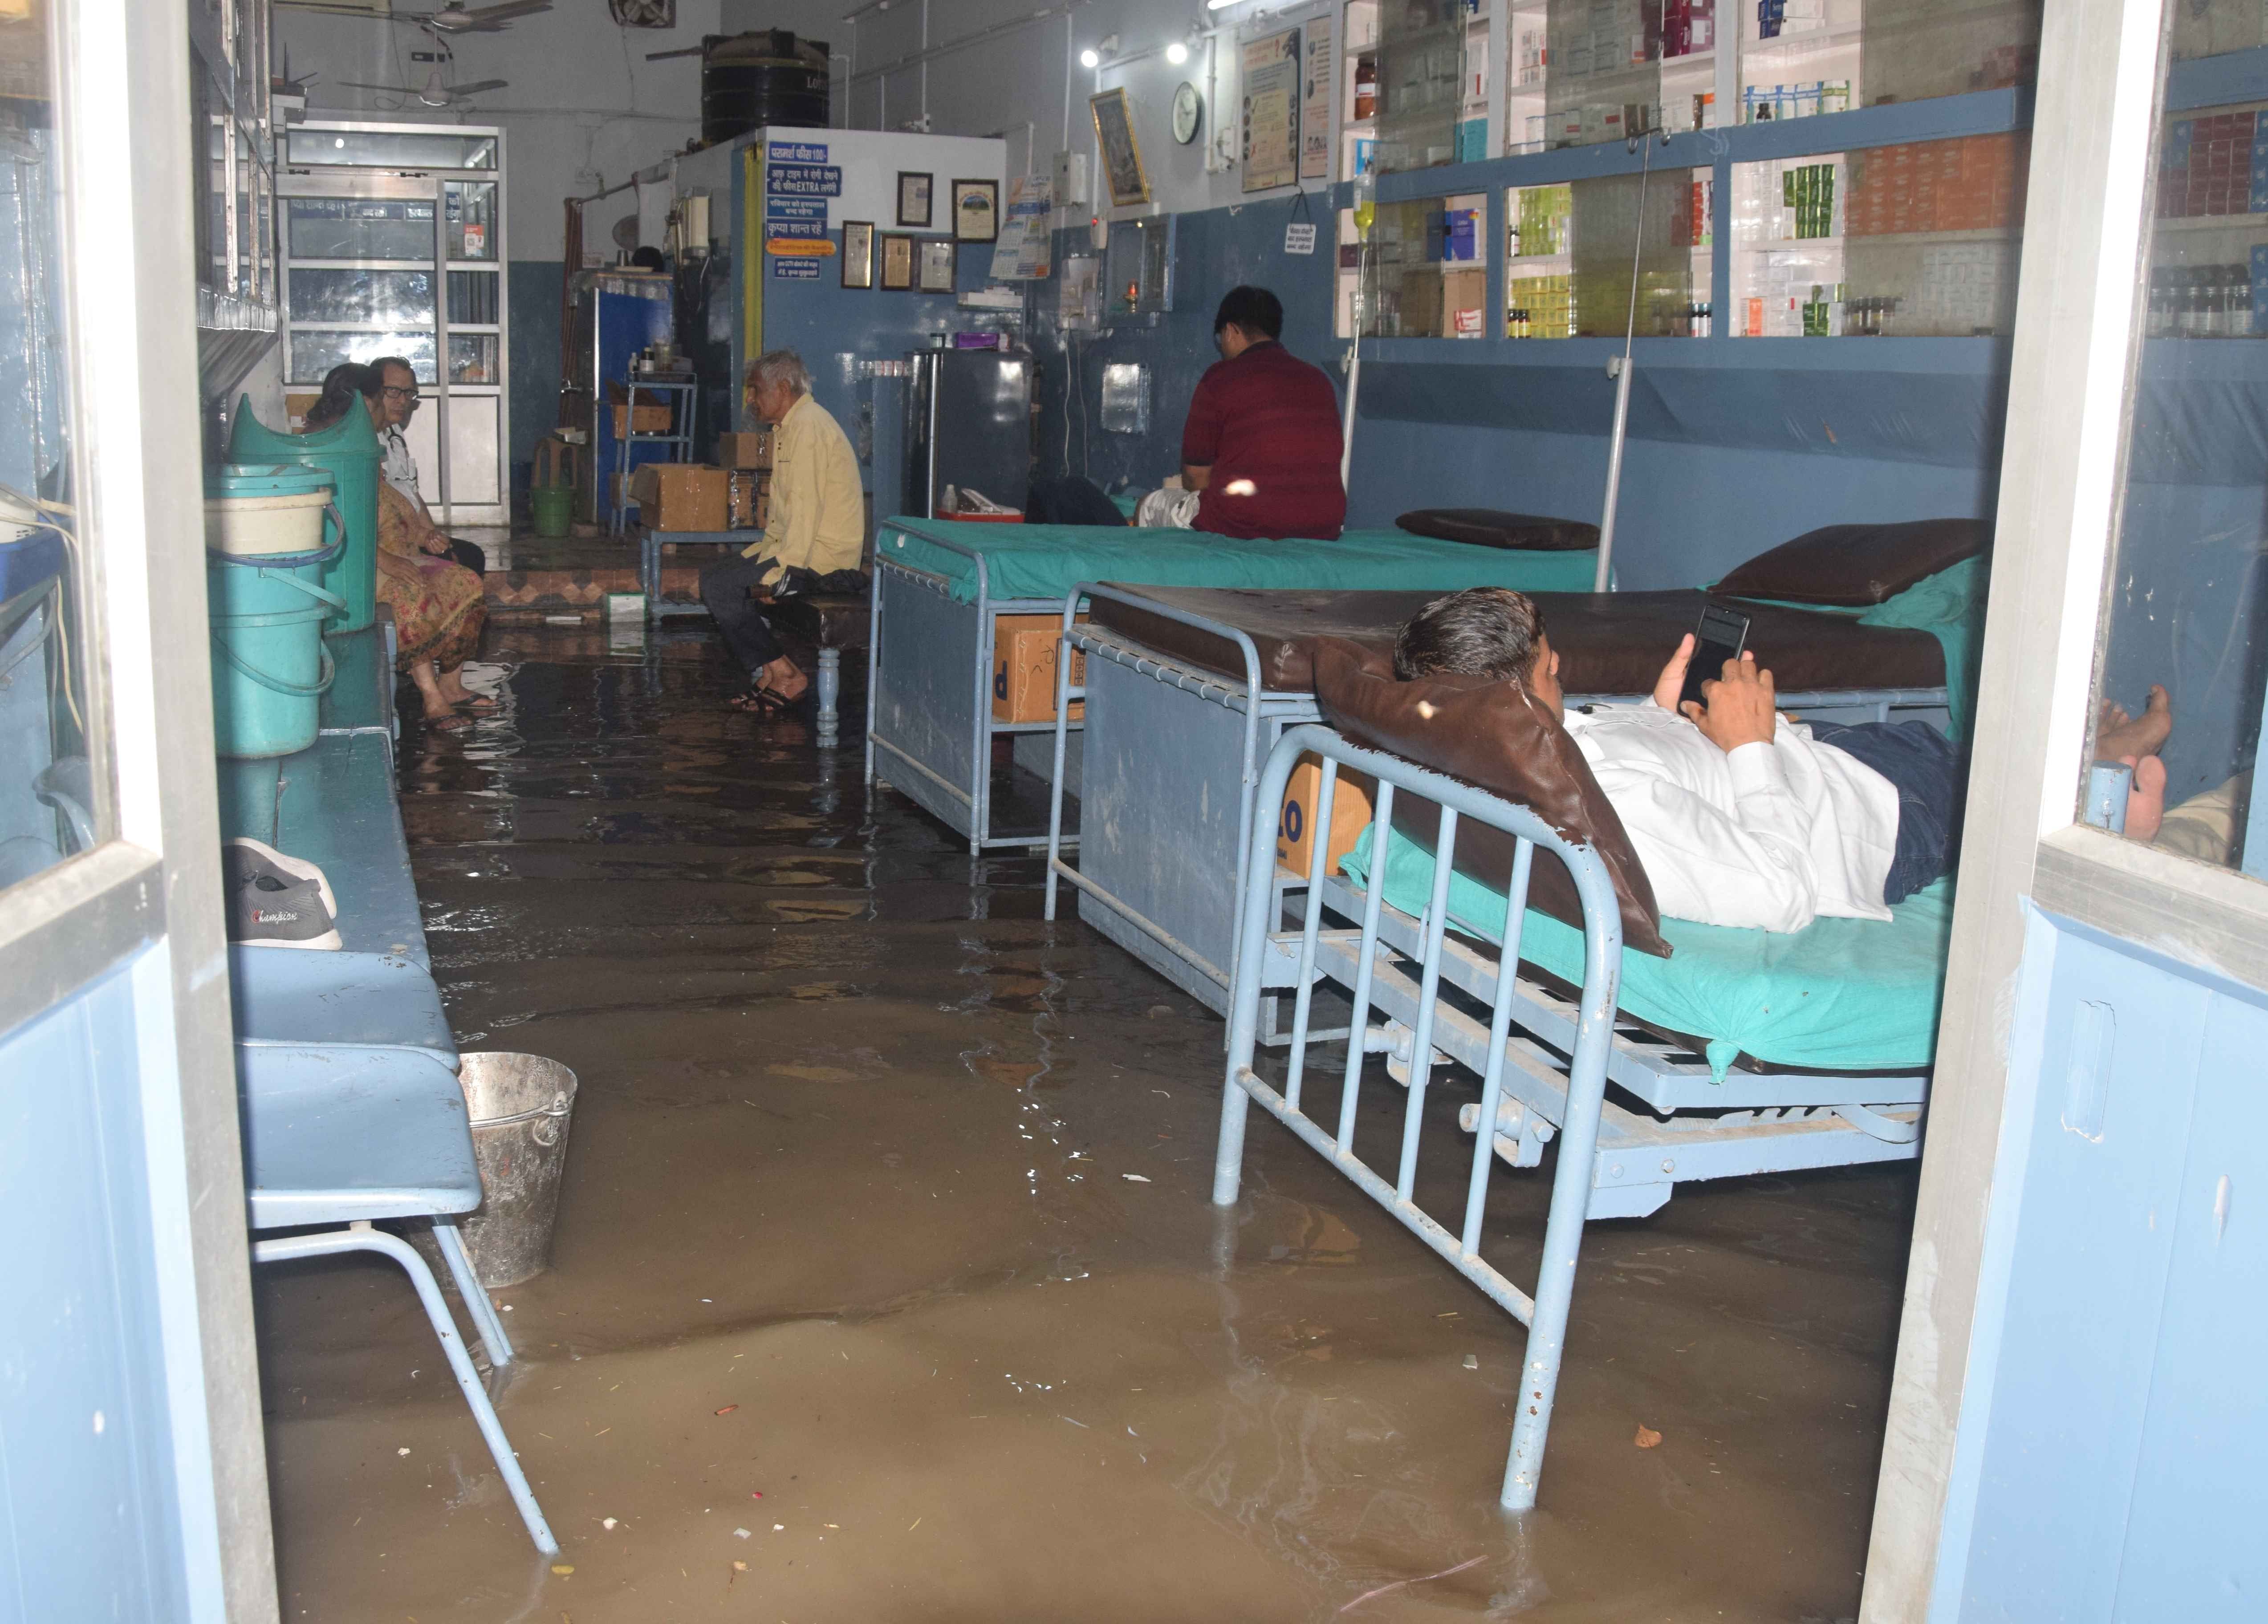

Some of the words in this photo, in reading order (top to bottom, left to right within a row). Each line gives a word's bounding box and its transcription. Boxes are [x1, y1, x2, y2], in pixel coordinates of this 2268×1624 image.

[797, 182, 819, 192] EXTRA
[789, 224, 809, 234] शान्त
[252, 910, 297, 924] Champion
